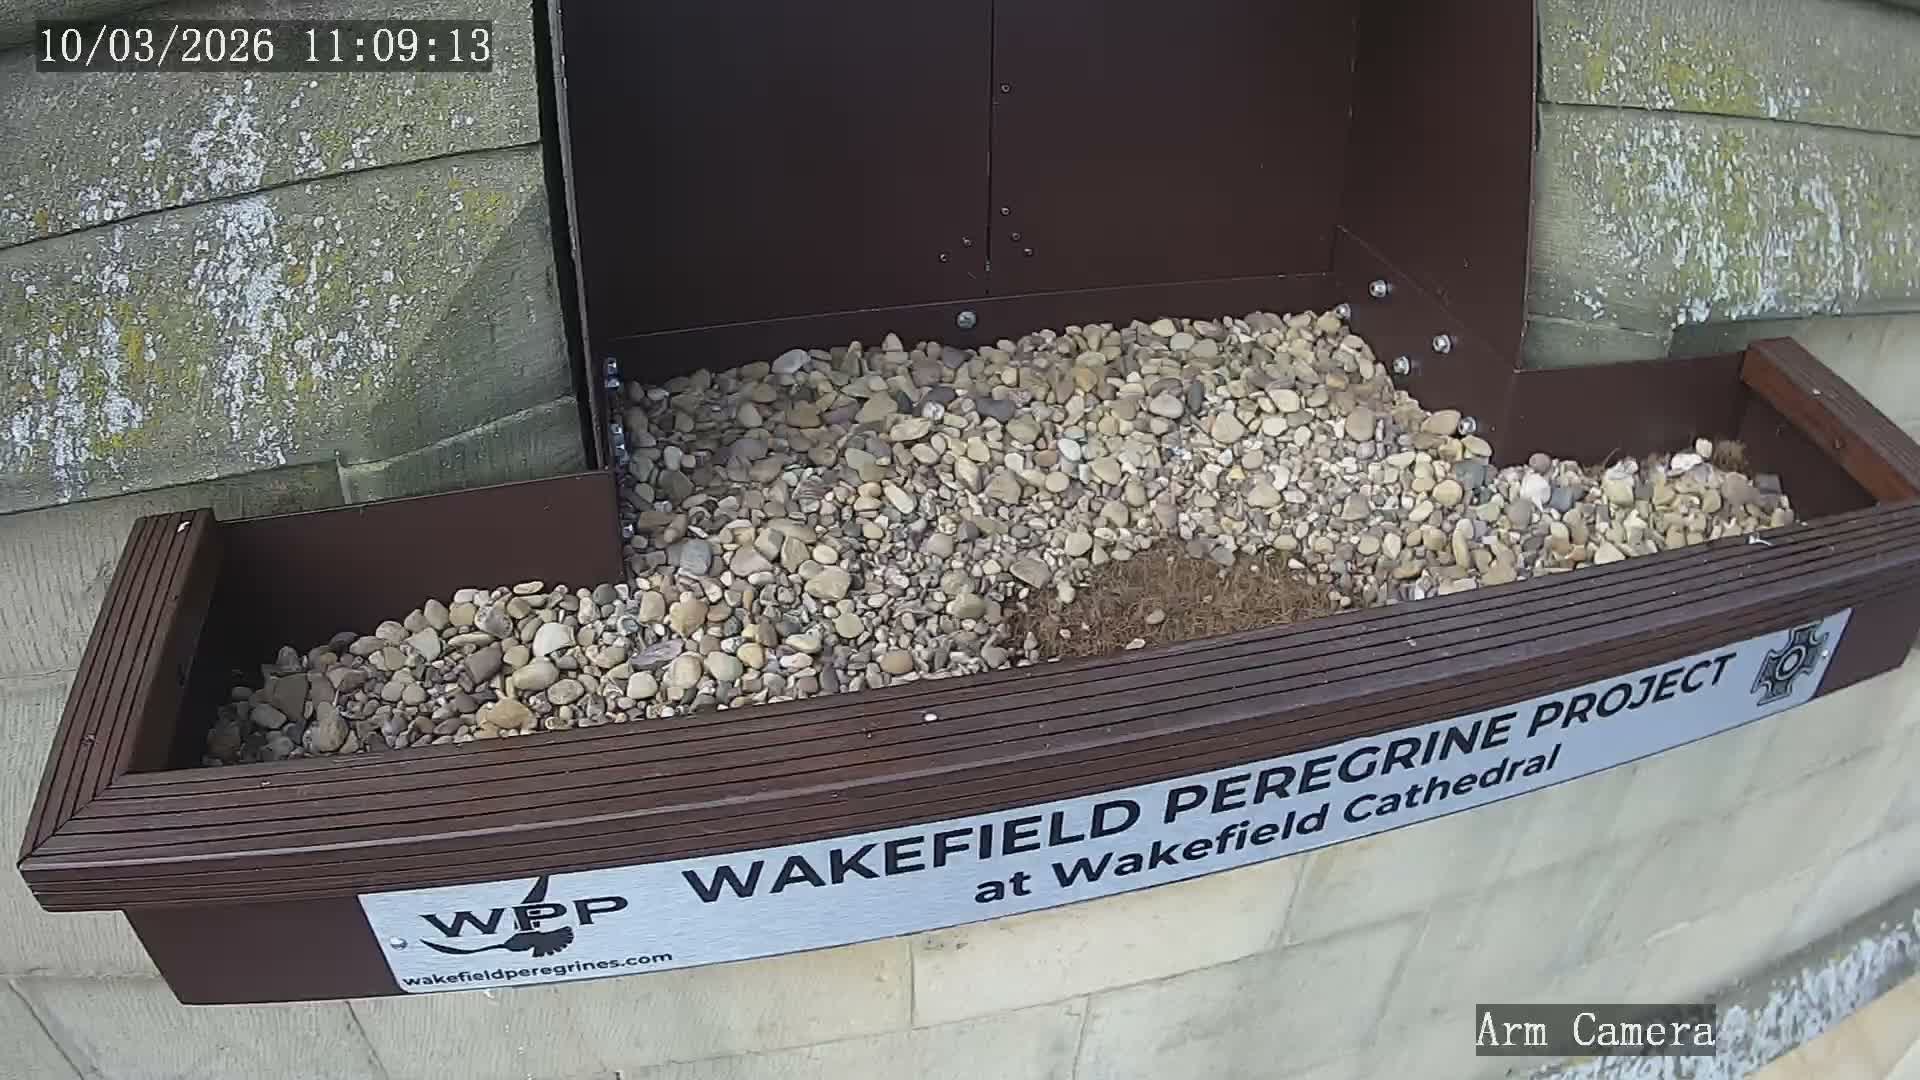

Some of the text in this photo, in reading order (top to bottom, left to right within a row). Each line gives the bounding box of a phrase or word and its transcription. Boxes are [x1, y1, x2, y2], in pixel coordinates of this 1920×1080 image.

[681, 652, 1738, 903] WAKEFIELD PEREGRINE PROJECT
[974, 743, 1561, 903] at Wakefield Cathedral
[419, 896, 629, 938] WPP
[403, 952, 673, 987] wakefieldperegrines.com
